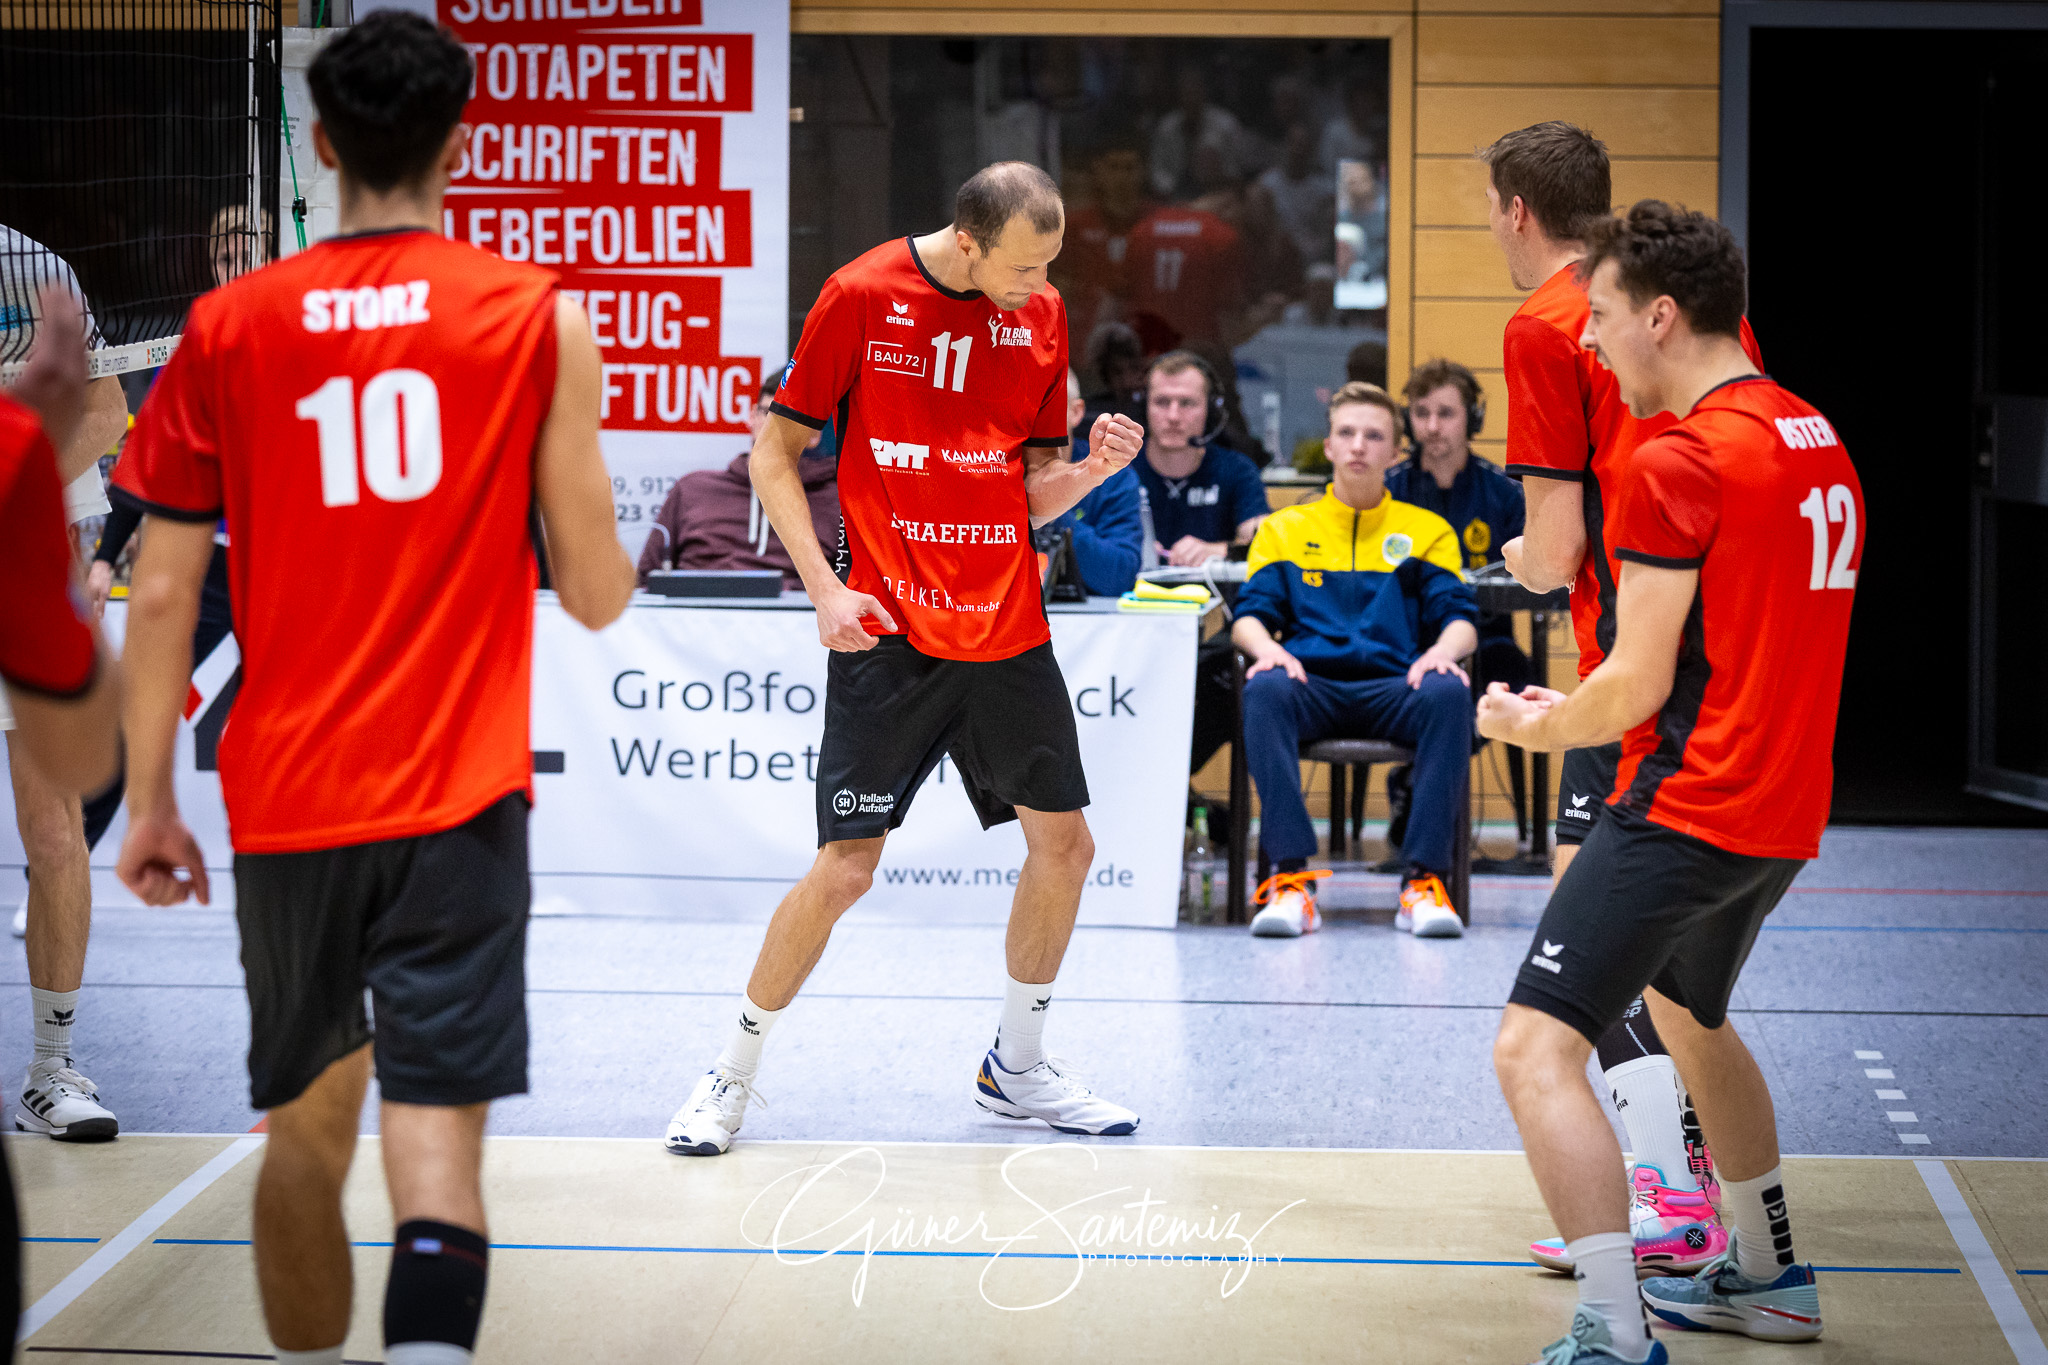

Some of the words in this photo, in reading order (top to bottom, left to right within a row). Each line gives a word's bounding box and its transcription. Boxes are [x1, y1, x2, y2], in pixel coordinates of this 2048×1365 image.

[460, 43, 726, 102] TOTAPETEN
[450, 123, 697, 187] SCHRIFTEN
[443, 205, 727, 265] EBEFOLIEN
[302, 279, 431, 333] STORZ
[559, 289, 711, 349] EUG-
[886, 315, 915, 327] erima
[1000, 337, 1032, 347] VOLLEYBALL
[1001, 326, 1012, 339] TV
[1012, 325, 1032, 340] BÜHL
[874, 350, 903, 365] BAU
[905, 354, 920, 367] 72
[931, 331, 974, 393] 11
[601, 363, 752, 424] FTUNG
[295, 368, 444, 508] 10
[1774, 415, 1838, 450] OSTER
[958, 463, 1009, 477] Consulting
[613, 476, 633, 497] 9,
[891, 512, 1018, 544] SHAEFFLER
[1799, 483, 1857, 591] 12
[838, 797, 851, 808] SH
[858, 803, 895, 814] Aufzüge
[859, 792, 895, 804] Hallasch
[1565, 808, 1591, 821] erima
